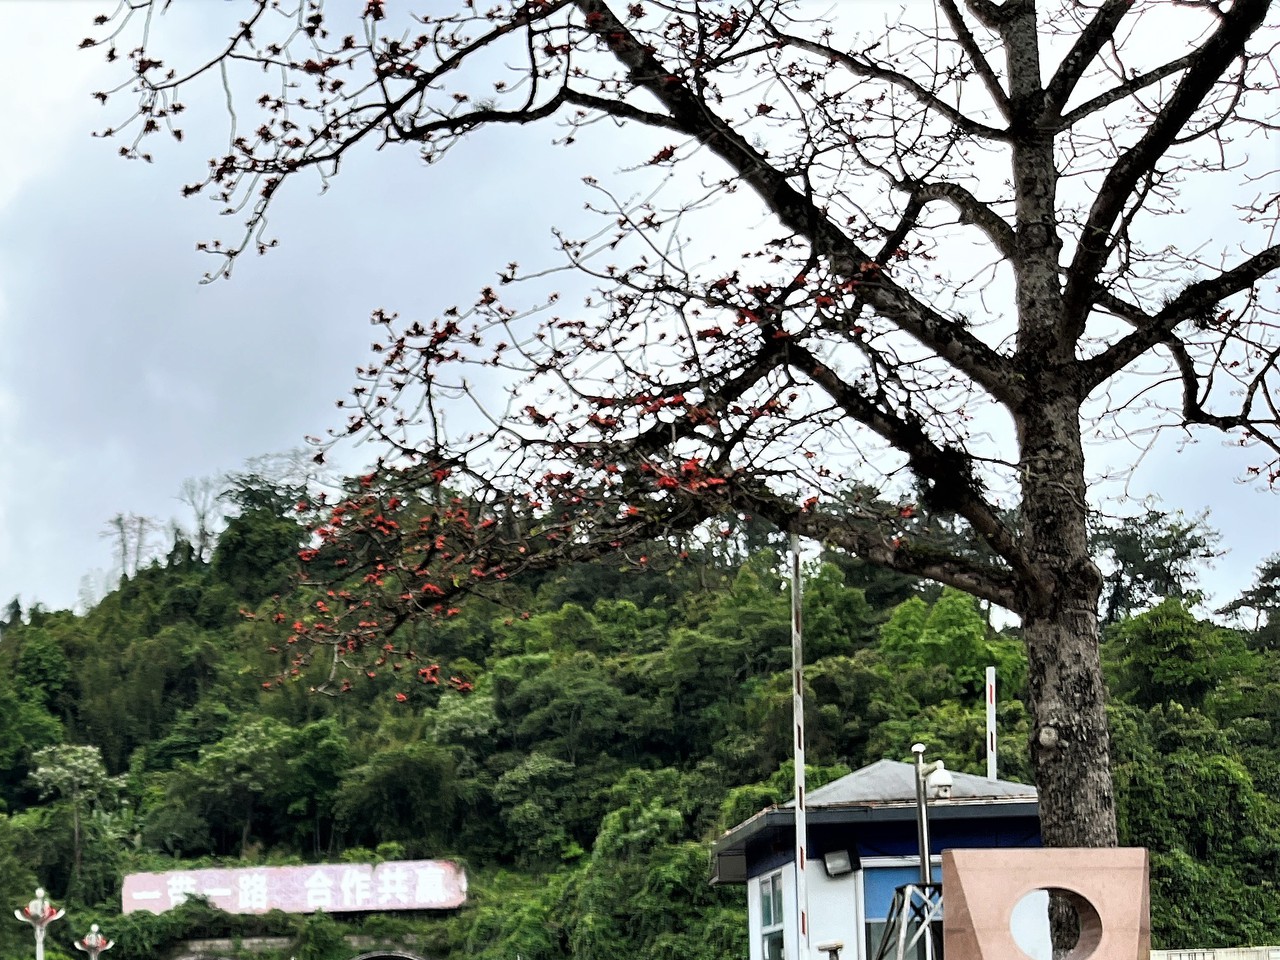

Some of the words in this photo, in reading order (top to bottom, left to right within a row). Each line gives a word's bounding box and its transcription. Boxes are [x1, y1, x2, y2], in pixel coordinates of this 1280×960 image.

[132, 874, 268, 910] 一带一路
[304, 867, 447, 905] 合作共赢
